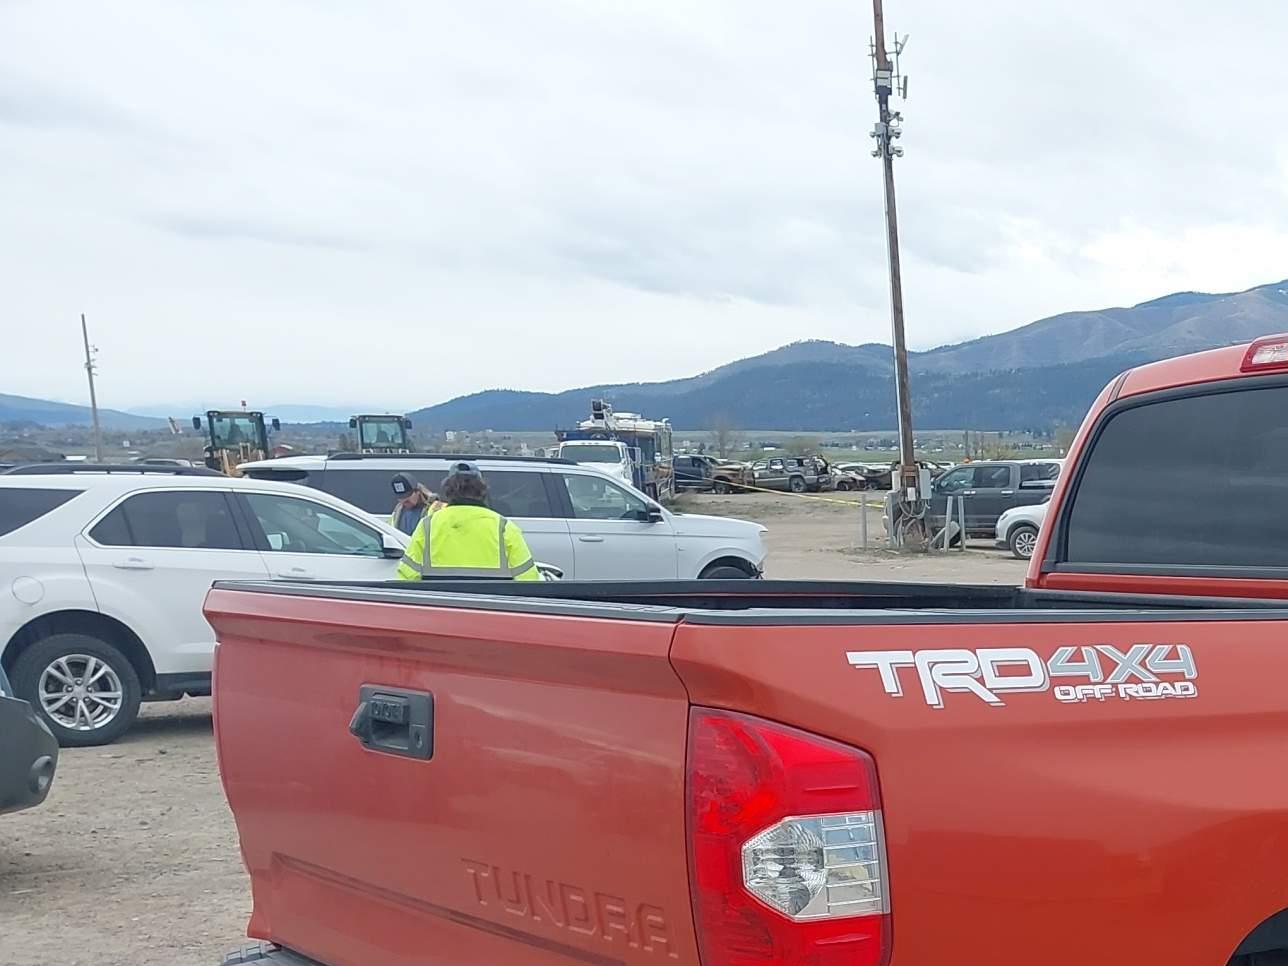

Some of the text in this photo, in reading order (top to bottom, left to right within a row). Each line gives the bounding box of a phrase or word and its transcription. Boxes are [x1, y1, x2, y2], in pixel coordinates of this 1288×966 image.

[846, 647, 1049, 709] TRD
[1053, 680, 1198, 703] OFF ROAD
[460, 857, 679, 960] TUNDRA
